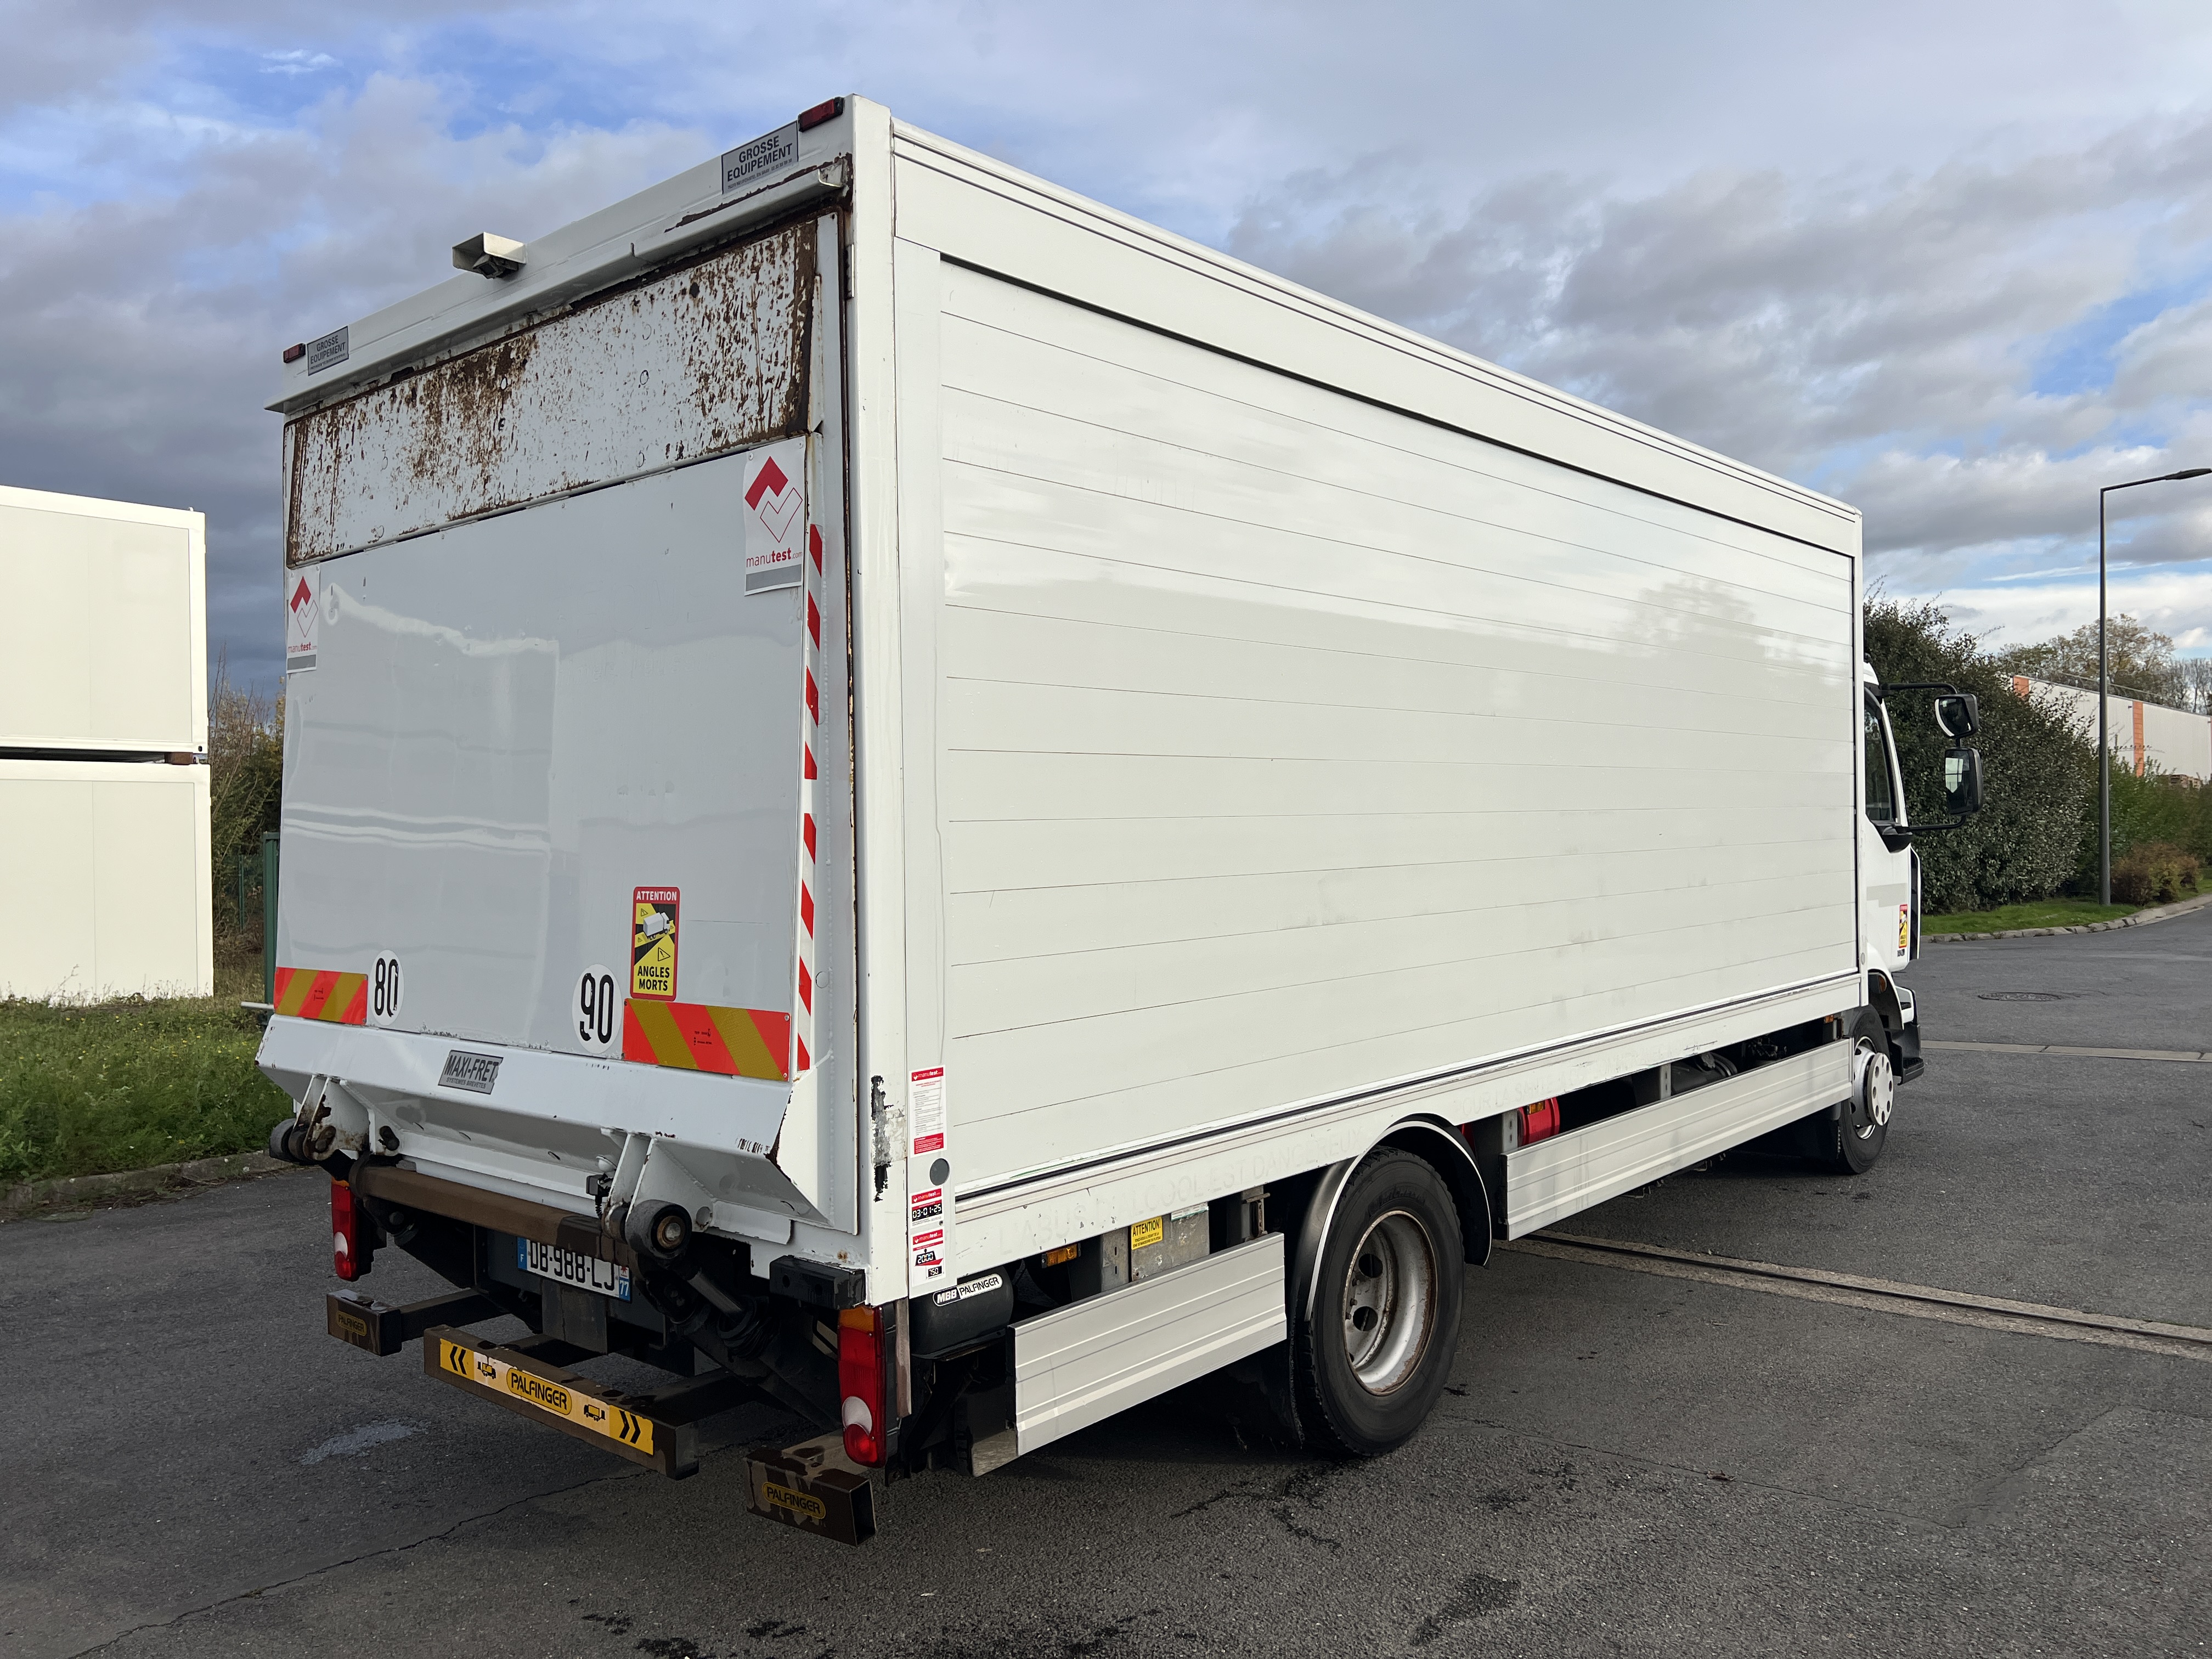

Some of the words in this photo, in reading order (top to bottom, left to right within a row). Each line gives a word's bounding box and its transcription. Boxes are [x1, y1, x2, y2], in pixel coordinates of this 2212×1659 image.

[739, 136, 779, 163] GROSSE
[727, 143, 793, 182] EQUIPEMENT
[311, 342, 346, 364] EQUIPEMENT
[317, 335, 338, 352] GROSSE
[746, 548, 803, 568] manutest.com
[636, 890, 677, 901] ATTENTION
[637, 966, 670, 978] ANGLES
[375, 958, 399, 1018] 80
[639, 978, 668, 991] MORTS
[579, 973, 614, 1043] 90
[444, 1054, 499, 1083] MAXI-FRET
[1132, 1218, 1161, 1237] ATTENTION!
[520, 1254, 524, 1262] F
[619, 1280, 629, 1296] 77
[937, 1289, 957, 1304] MBB
[959, 1277, 1000, 1296] PALFINGER
[511, 1372, 568, 1410] PALFINGER
[766, 1486, 821, 1514] PALFINGER
